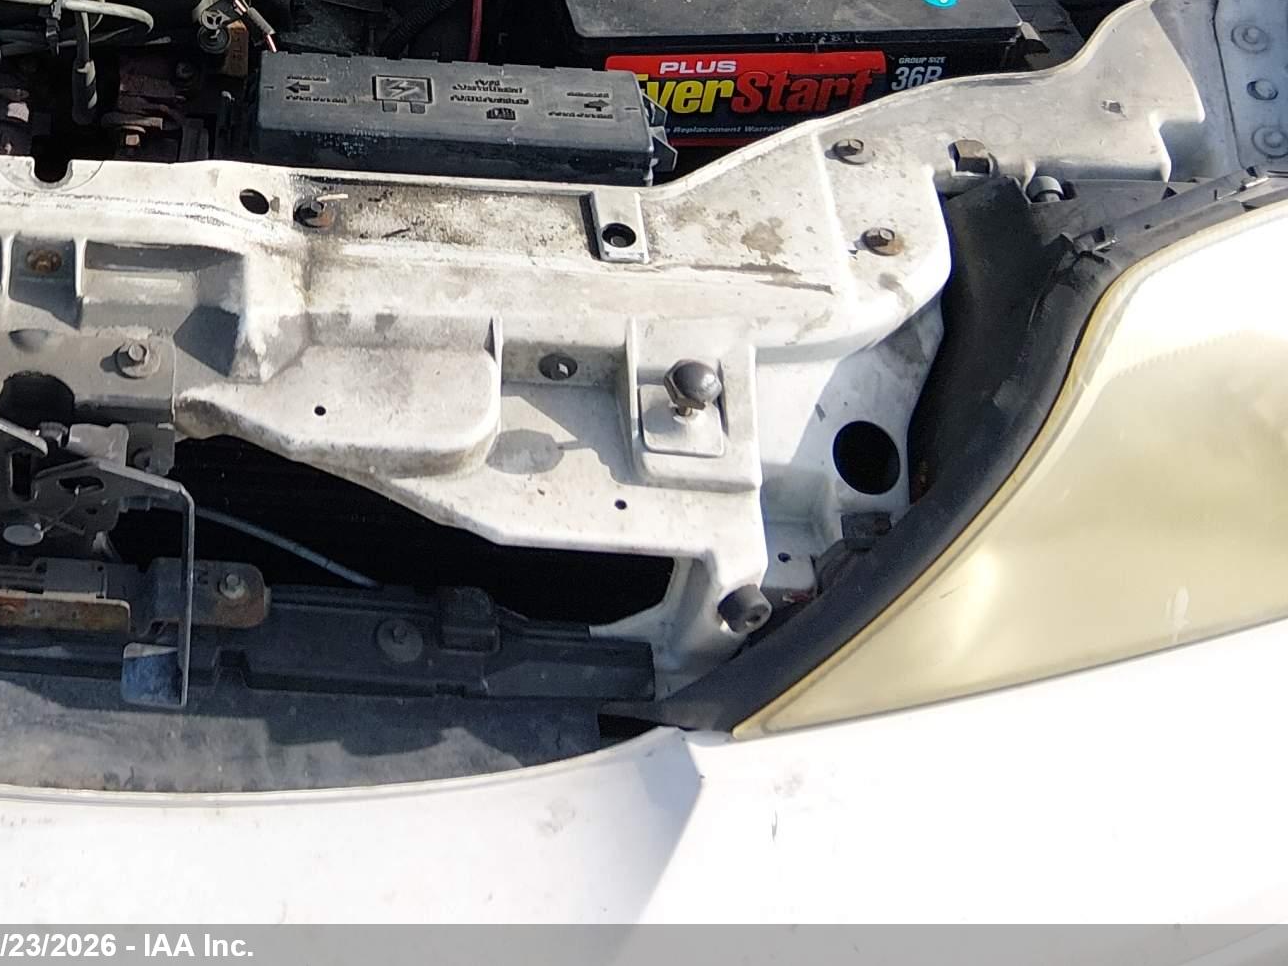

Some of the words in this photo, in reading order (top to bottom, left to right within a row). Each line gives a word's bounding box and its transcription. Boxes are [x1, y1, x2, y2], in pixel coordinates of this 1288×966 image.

[898, 57, 927, 65] GROUP
[928, 56, 947, 64] SIZE
[659, 60, 738, 75] PLUS
[673, 126, 741, 134] Replacement
